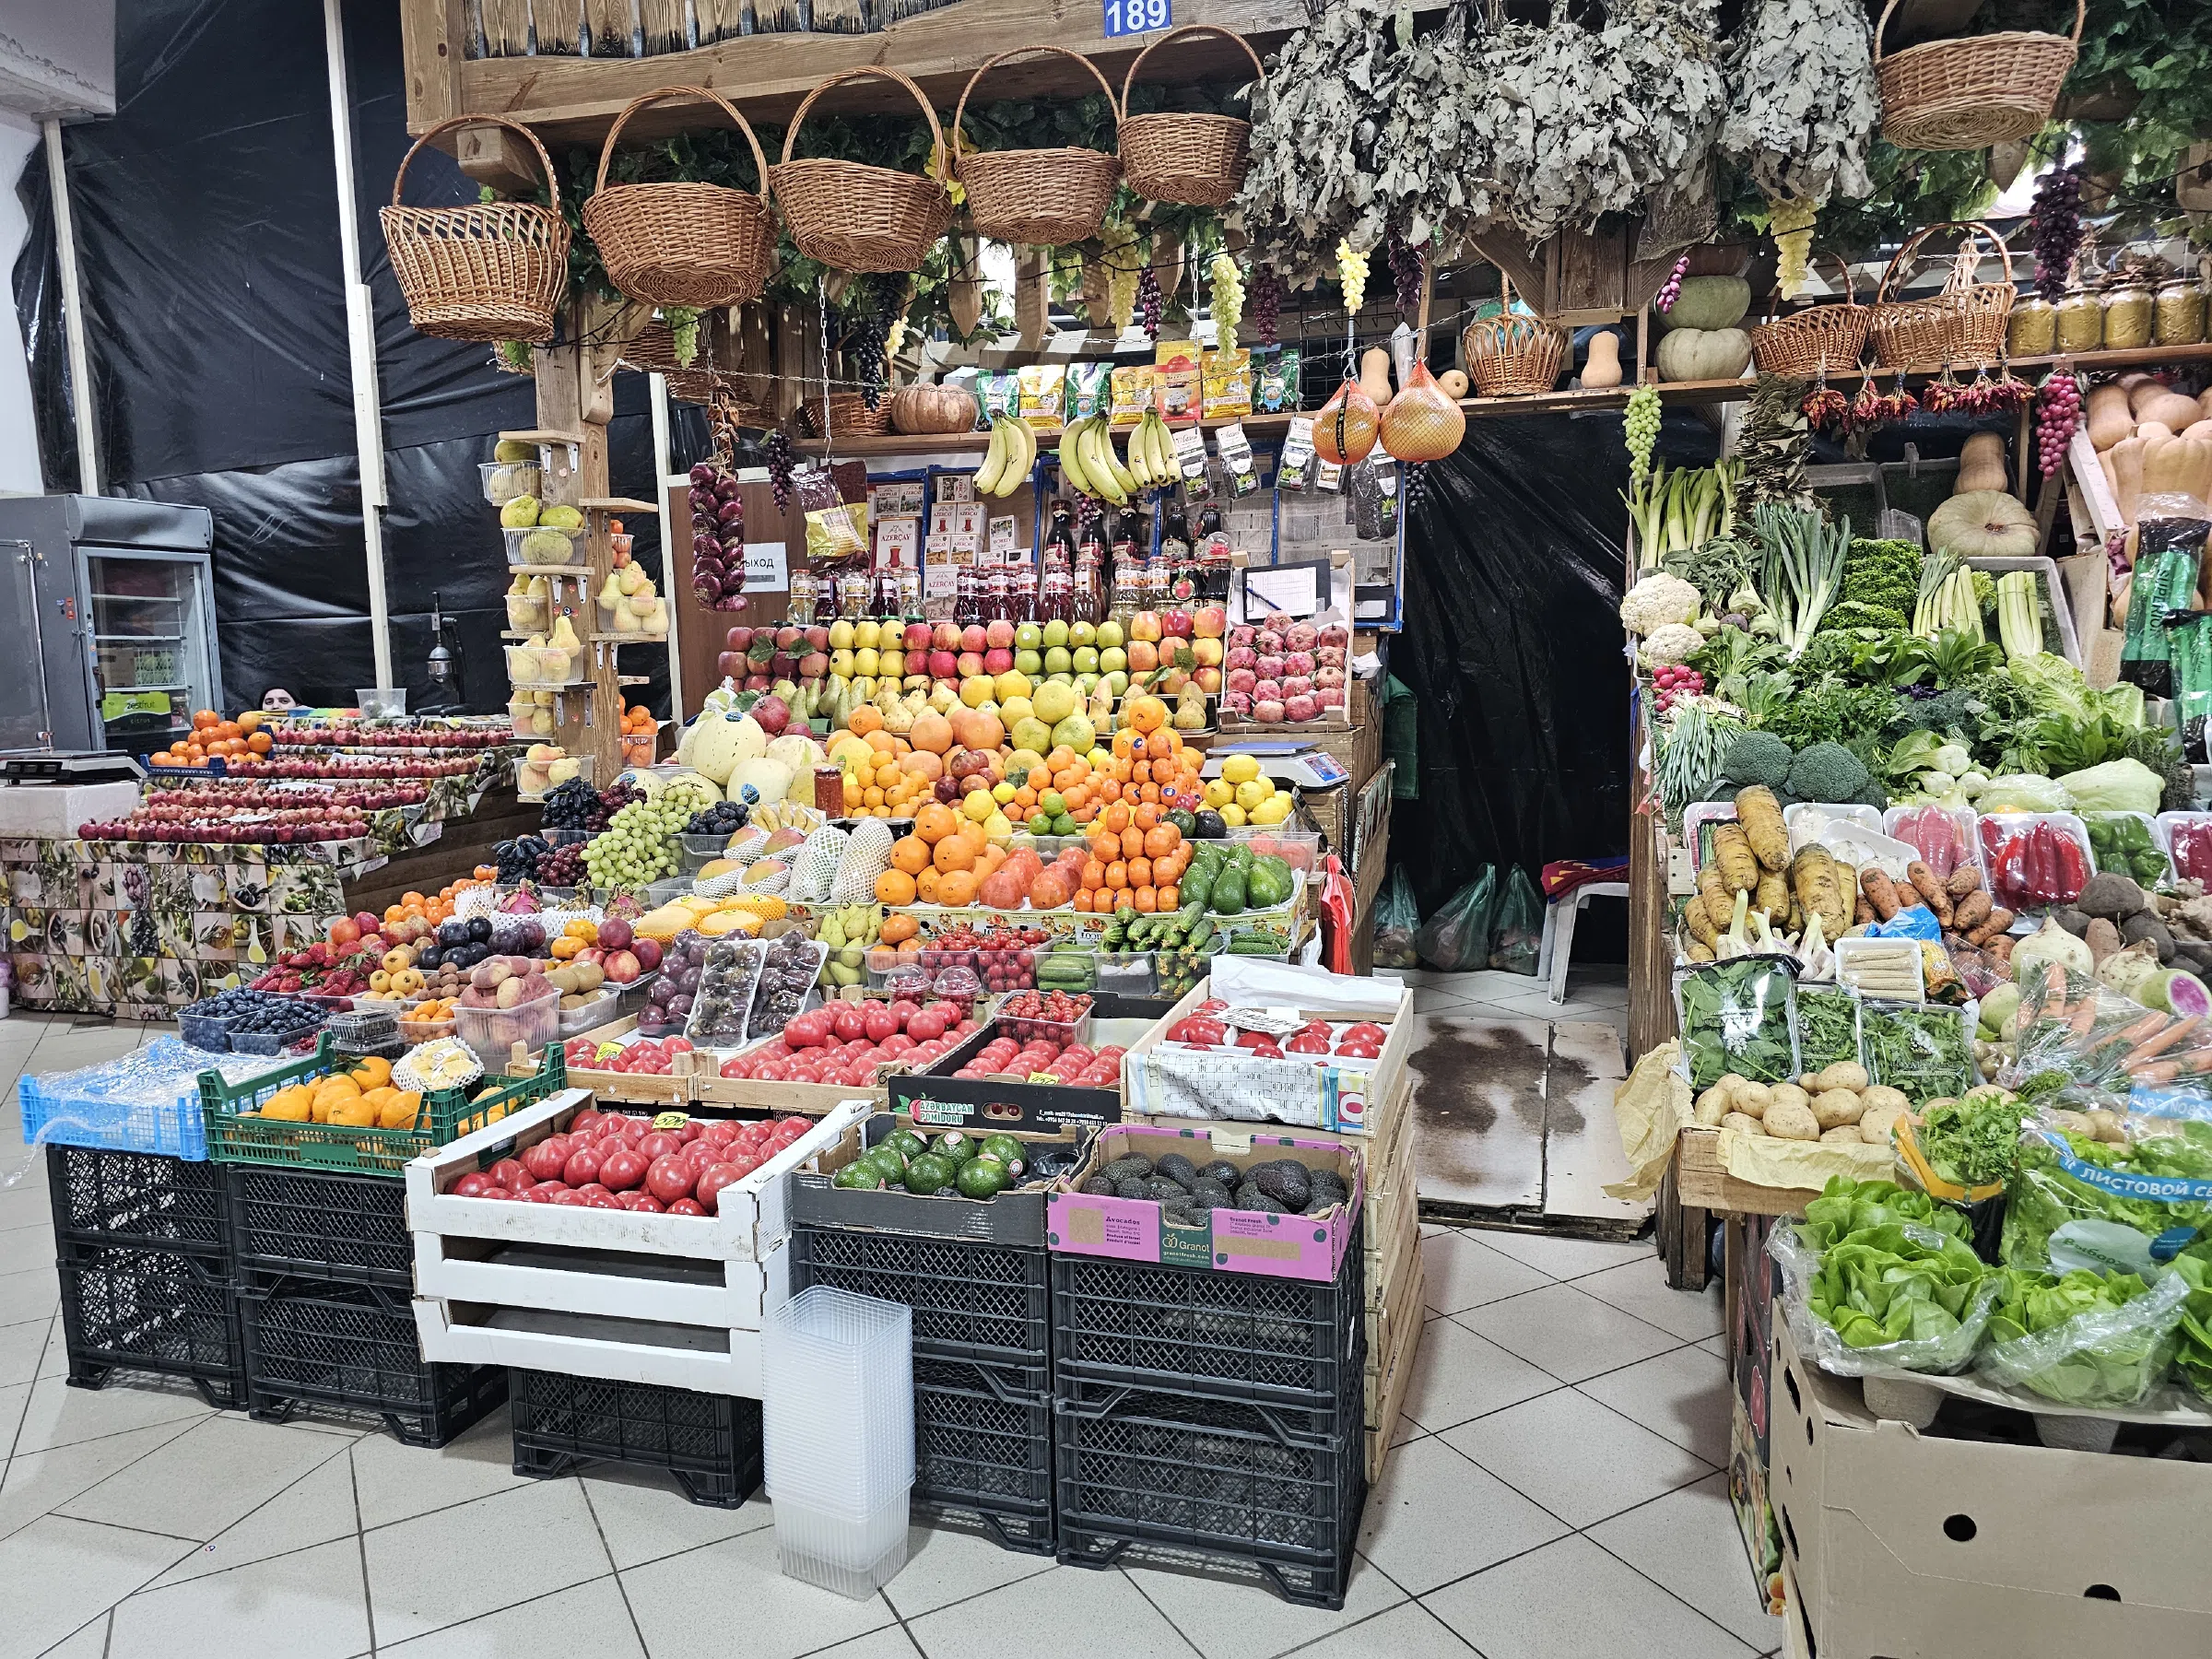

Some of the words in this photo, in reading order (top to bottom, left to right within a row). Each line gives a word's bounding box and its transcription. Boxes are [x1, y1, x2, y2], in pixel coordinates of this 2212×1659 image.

[1107, 0, 1168, 33] 189
[881, 534, 912, 542] AZERÇAY
[745, 558, 774, 569] ЫХОД
[878, 1069, 889, 1085] 6
[920, 1100, 974, 1113] AZƏRBAYCAN
[920, 1112, 964, 1124] POMİDORU
[2079, 1167, 2190, 1196] ЛИСТОВОЙ
[1105, 1217, 1141, 1225] Avocados
[1179, 1241, 1210, 1253] Granot
[1163, 1251, 1210, 1260] granotfresh.com
